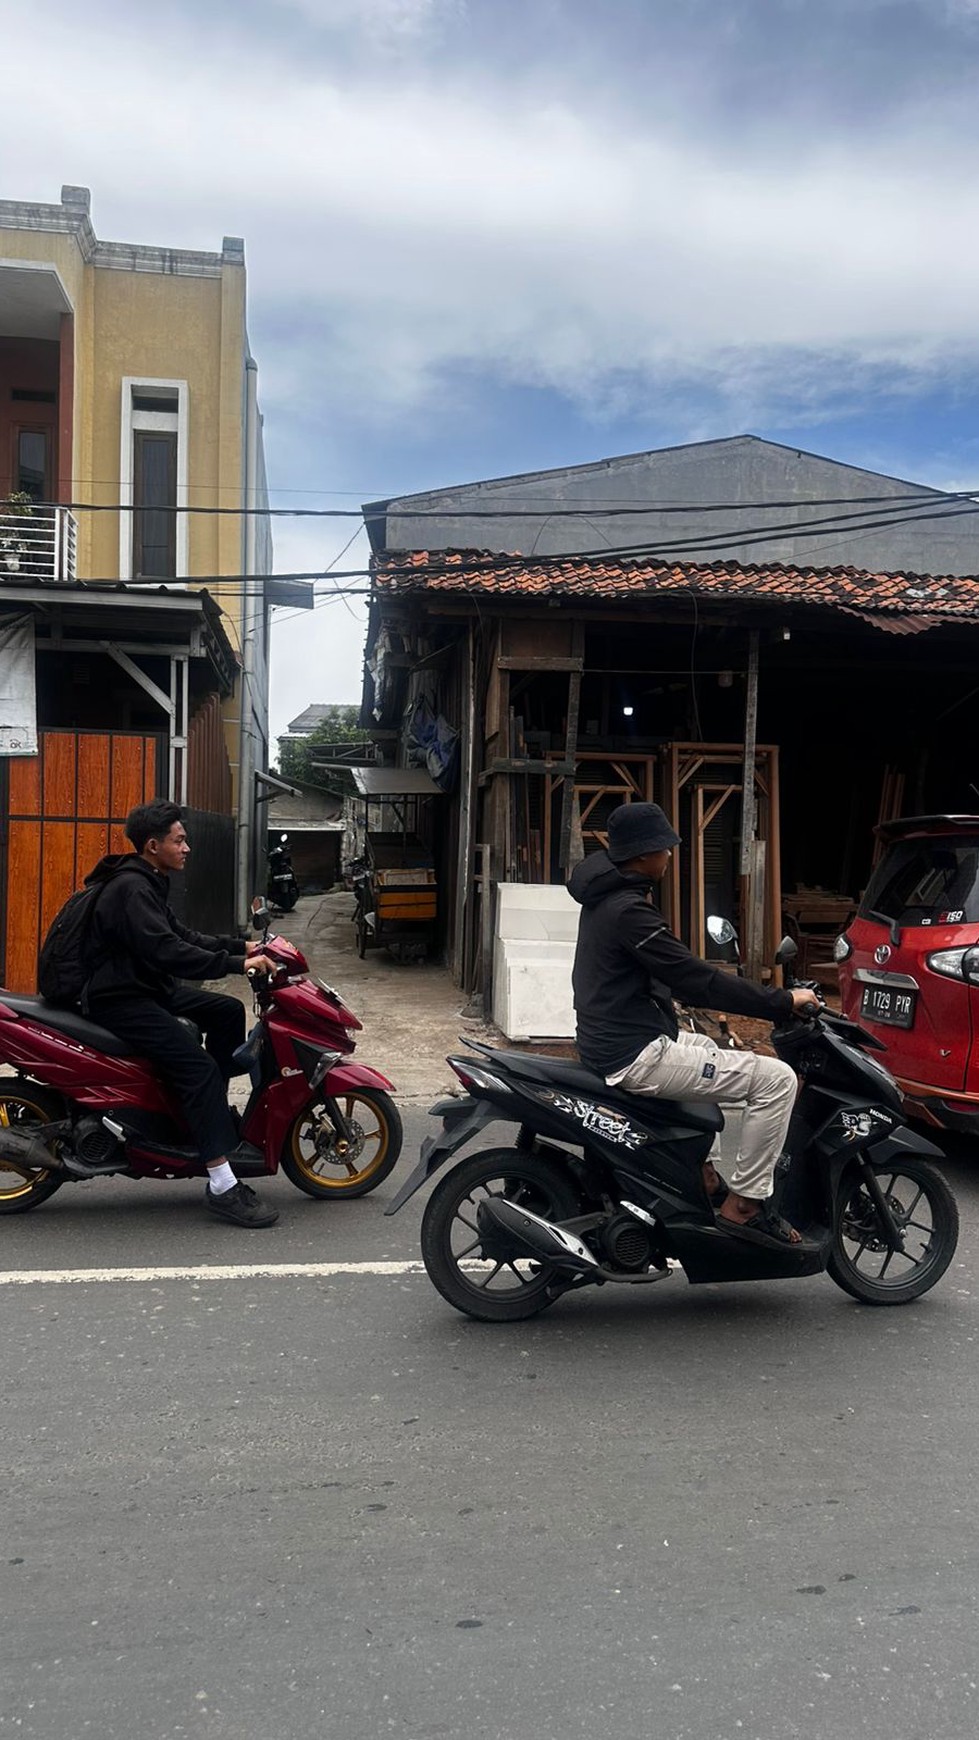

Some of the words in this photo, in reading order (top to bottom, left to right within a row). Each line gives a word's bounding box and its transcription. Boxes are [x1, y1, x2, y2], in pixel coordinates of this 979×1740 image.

[863, 989, 870, 1005] B
[873, 991, 891, 1009] 1729
[895, 995, 911, 1013] PYR
[574, 1100, 631, 1142] Street
[870, 1109, 892, 1124] HONDA
